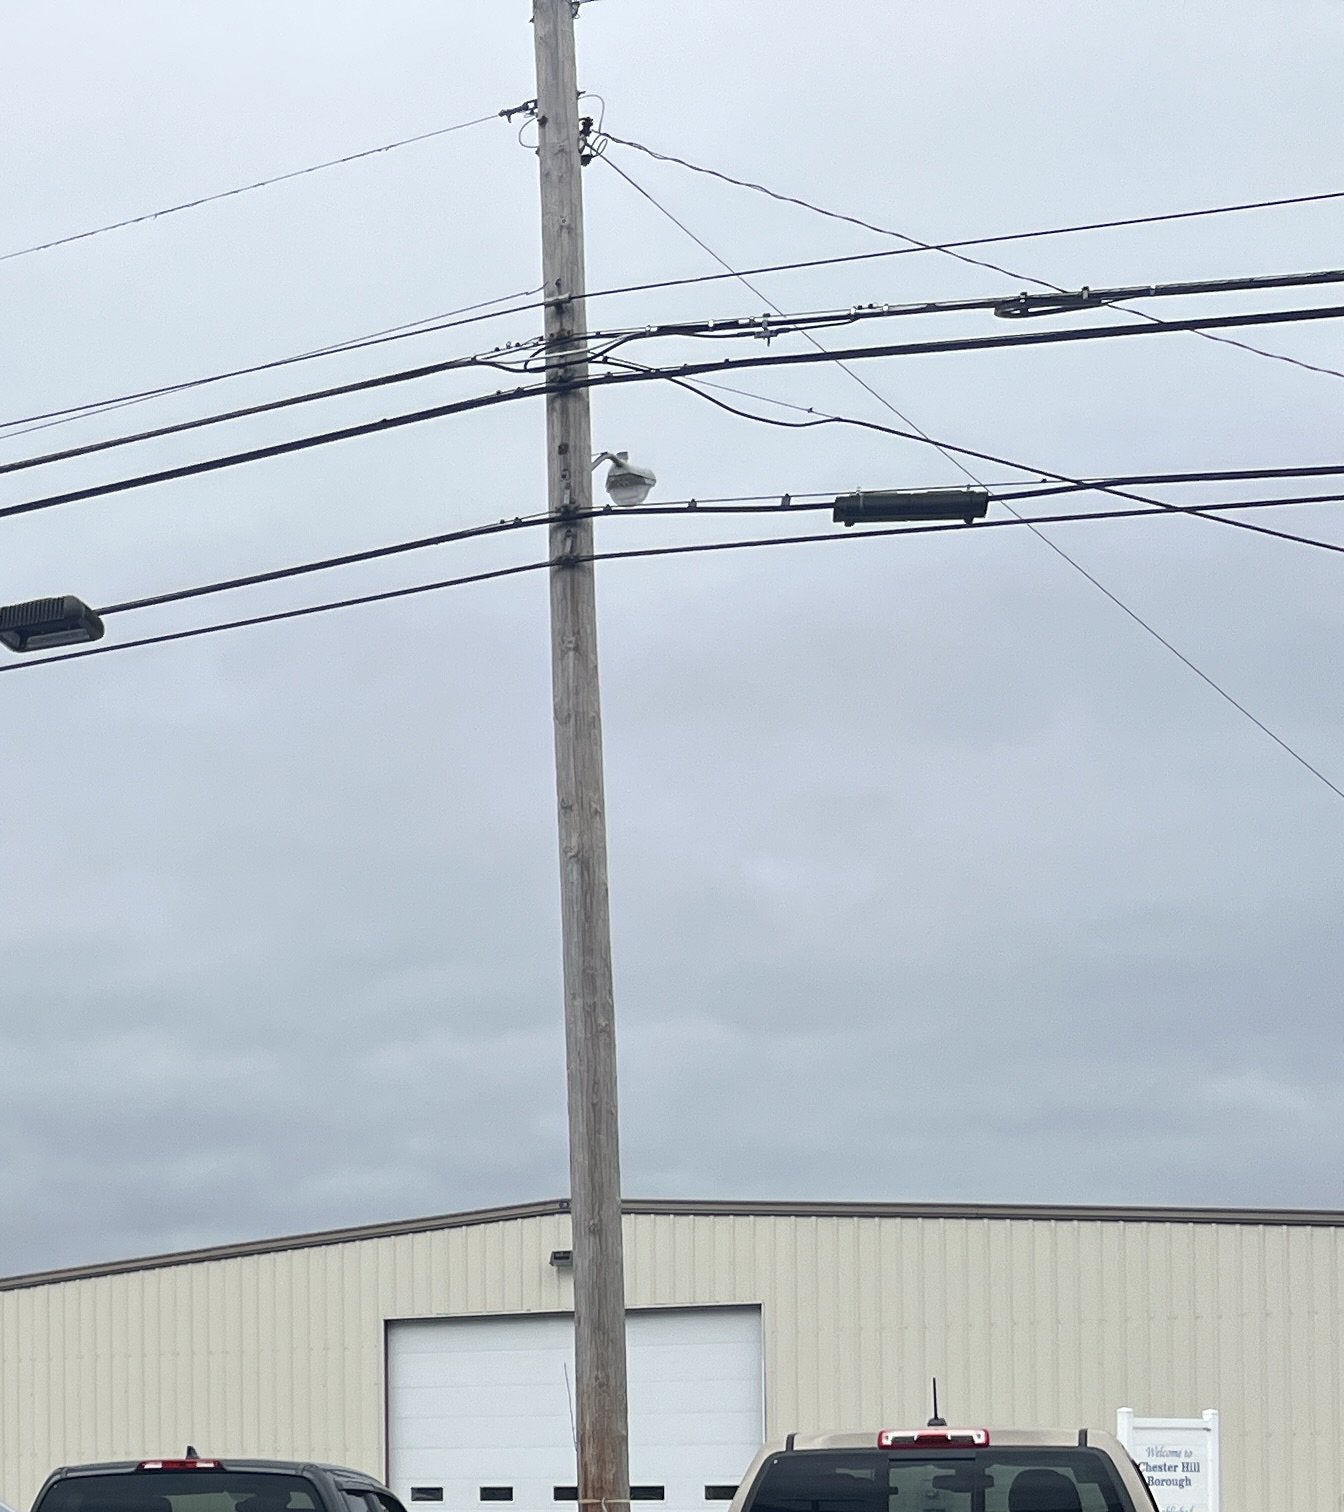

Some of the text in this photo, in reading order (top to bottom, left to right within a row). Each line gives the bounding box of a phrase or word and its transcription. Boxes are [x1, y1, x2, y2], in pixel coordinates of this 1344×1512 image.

[1146, 1446, 1193, 1458] Welcome to
[1138, 1462, 1200, 1473] Chester Hill
[1147, 1476, 1192, 1488] Borough
